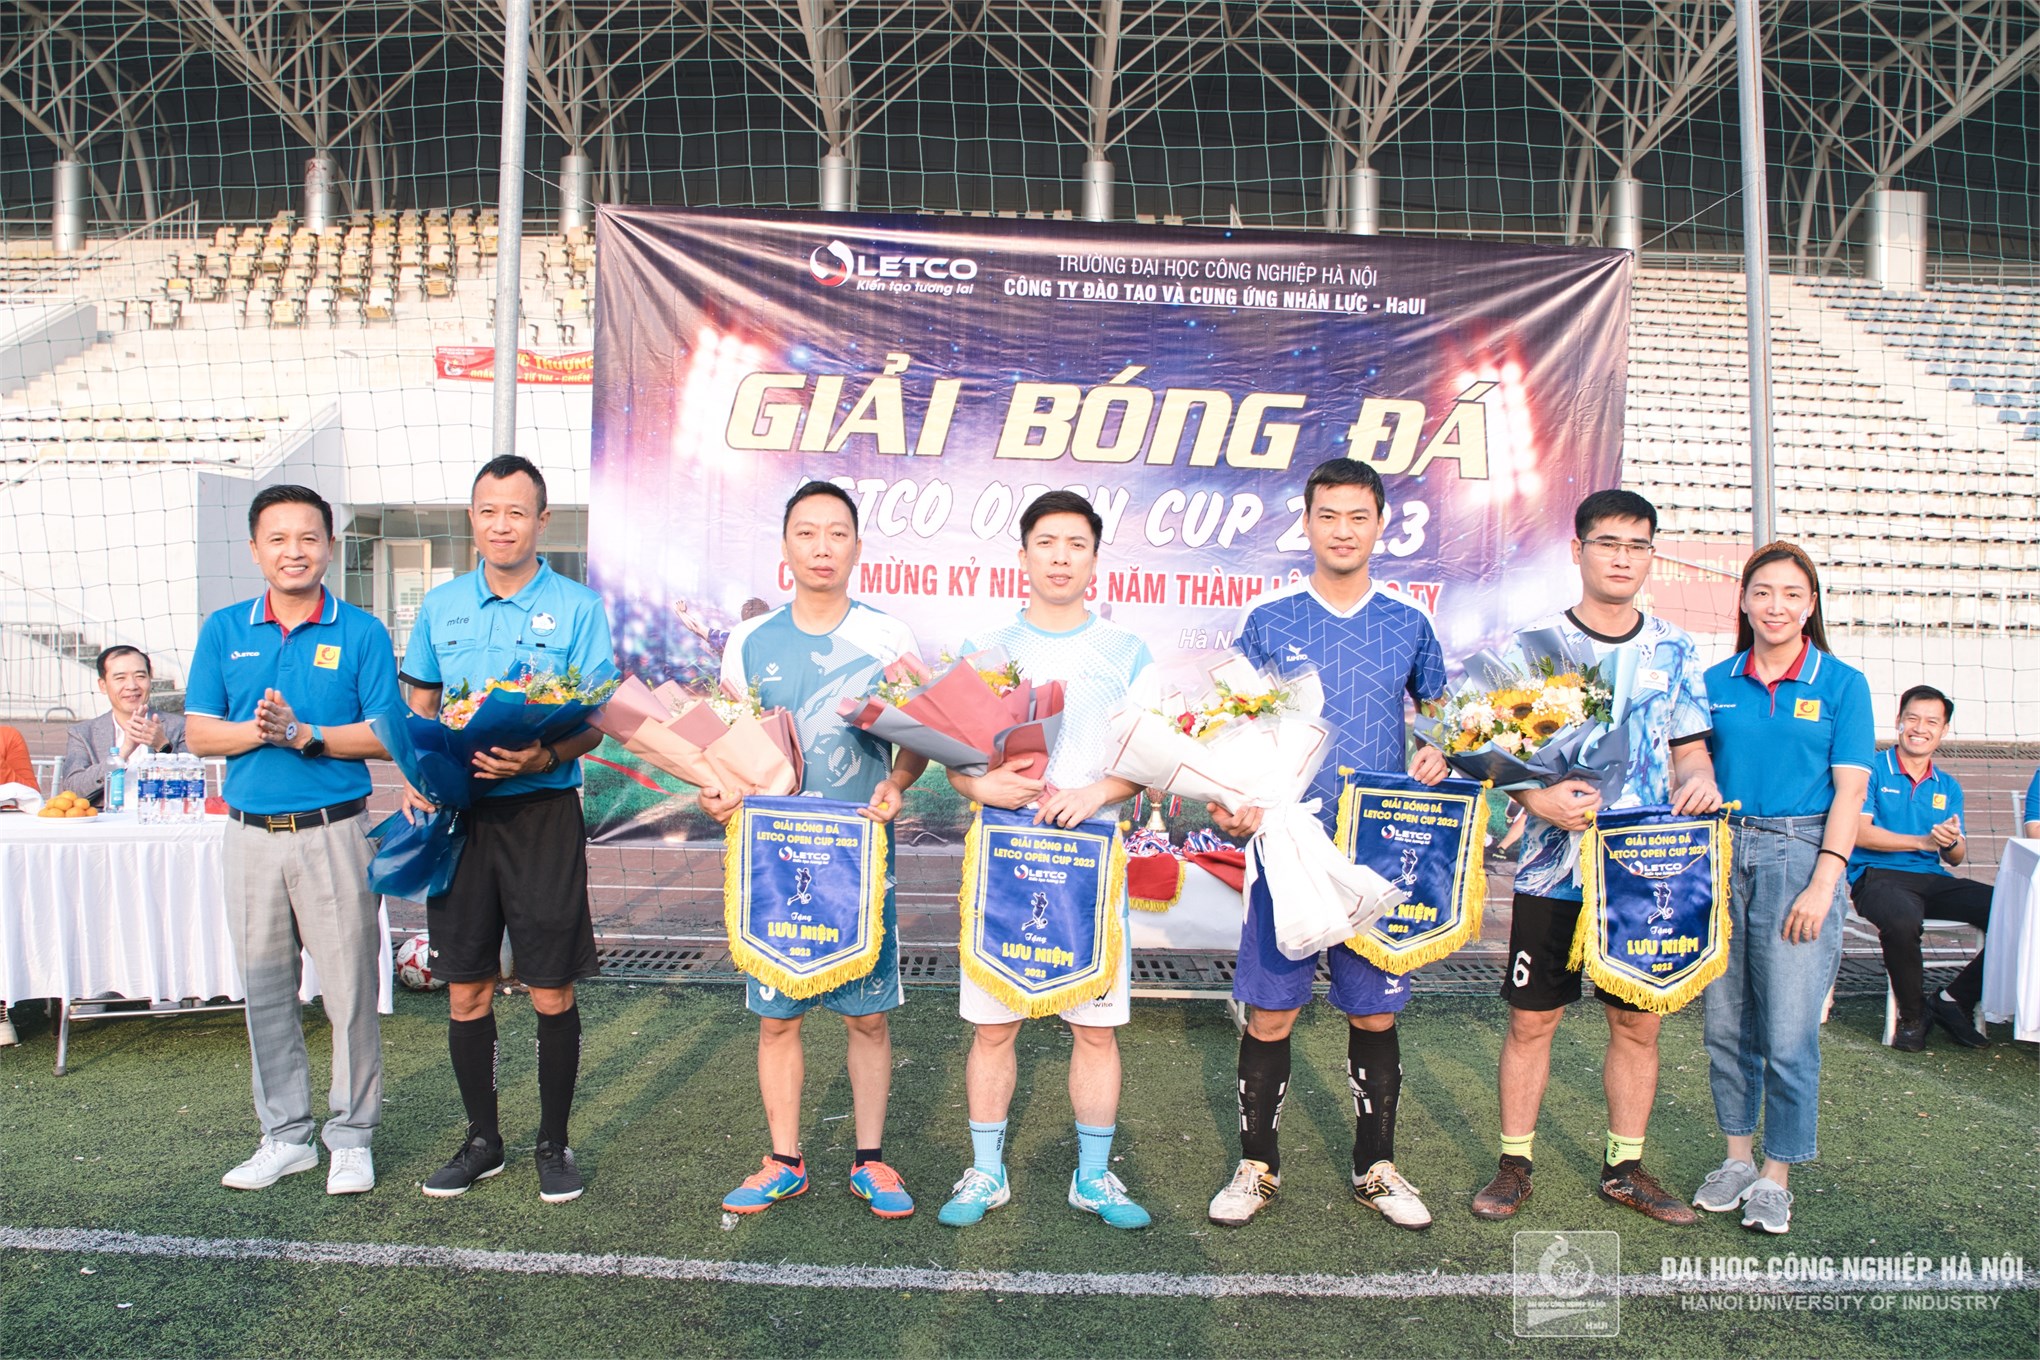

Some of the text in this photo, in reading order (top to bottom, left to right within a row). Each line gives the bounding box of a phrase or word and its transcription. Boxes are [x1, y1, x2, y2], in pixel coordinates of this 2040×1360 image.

[857, 256, 978, 280] LETCO
[1057, 252, 1377, 289] TRƯỜNG ĐẠI HỌC CÔNG NGHIỆP HÀ NỘI
[857, 278, 974, 296] Kiến tạo tương lai
[1004, 275, 1052, 297] CÔNG
[1057, 281, 1079, 298] TY
[1083, 278, 1118, 300] ĐÀO
[1124, 284, 1156, 304] TẠO
[1162, 282, 1185, 303] VÀ
[1190, 286, 1237, 306] CUNG
[1243, 286, 1277, 307] ỨNG
[1283, 289, 1329, 310] NHÂN
[1335, 293, 1367, 315] LỰC
[1385, 297, 1426, 315] HaUI
[725, 353, 1500, 480] GIẢI BÓNG ĐÁ
[793, 475, 953, 538] TCO
[1144, 488, 1264, 549] CUP
[860, 556, 938, 596] MỪNG
[948, 556, 981, 597] KỶ
[1108, 566, 1166, 604] NĂM
[1176, 568, 1262, 607] THÀNH
[1409, 584, 1440, 614] TY
[1178, 628, 1208, 650] Hà
[1381, 798, 1442, 813] GIẢI BÓNG ĐÁ
[773, 819, 839, 834] GIẢI BÓNG ĐÁ
[1363, 809, 1458, 828] LETCO OPEN CUP 2023
[757, 832, 858, 847] LETCO OPEN CUP 2023
[1010, 836, 1078, 853] GIẢI BÓNG ĐÁ
[1395, 829, 1432, 840] LETCO
[1625, 832, 1691, 846] GIẢI BÓNG ĐÁ
[793, 851, 830, 860] LETCO
[994, 848, 1095, 868] LETCO OPEN CUP 2023
[1609, 845, 1707, 859] LETCO OPEN CUP 2023
[1029, 869, 1067, 880] LETCO
[1644, 863, 1682, 872] LETCO
[1398, 902, 1438, 923] NIỆM
[768, 921, 839, 944] LƯU NIỆM
[1002, 942, 1074, 968] LƯU NIỆM
[1627, 935, 1699, 957] LƯU NIỆM
[1512, 950, 1532, 988] 6
